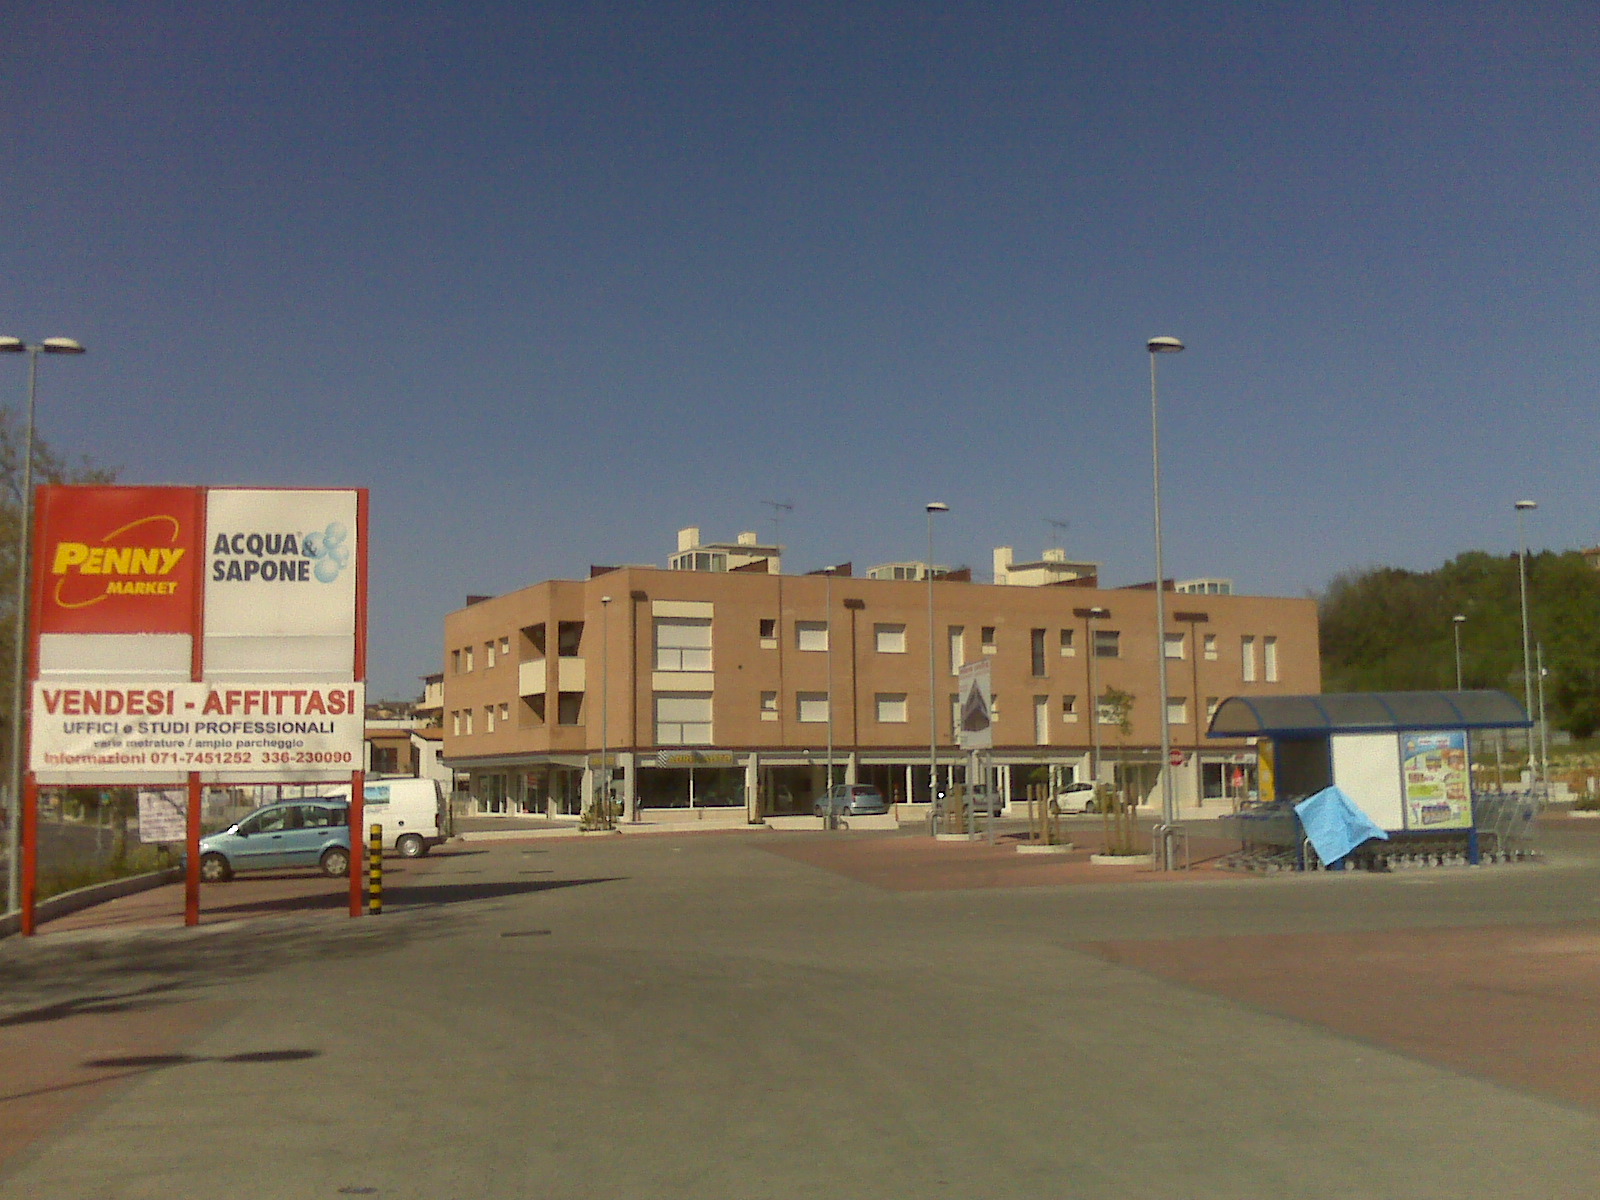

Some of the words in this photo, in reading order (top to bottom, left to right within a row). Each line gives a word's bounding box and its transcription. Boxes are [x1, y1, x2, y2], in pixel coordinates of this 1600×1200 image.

[52, 541, 185, 575] PENNY
[213, 560, 310, 581] SAPONE
[106, 581, 177, 595] MARKET
[42, 690, 174, 715] VENDESI
[202, 690, 355, 715] AFFITTASI
[63, 722, 118, 734] UFFICI
[138, 722, 189, 734] STUDI
[195, 721, 334, 734] PROFESSIONALI
[195, 738, 232, 749] ampio
[236, 738, 304, 749] parcheggio
[44, 752, 146, 764] Informazioni
[151, 752, 252, 764] 071-7451252
